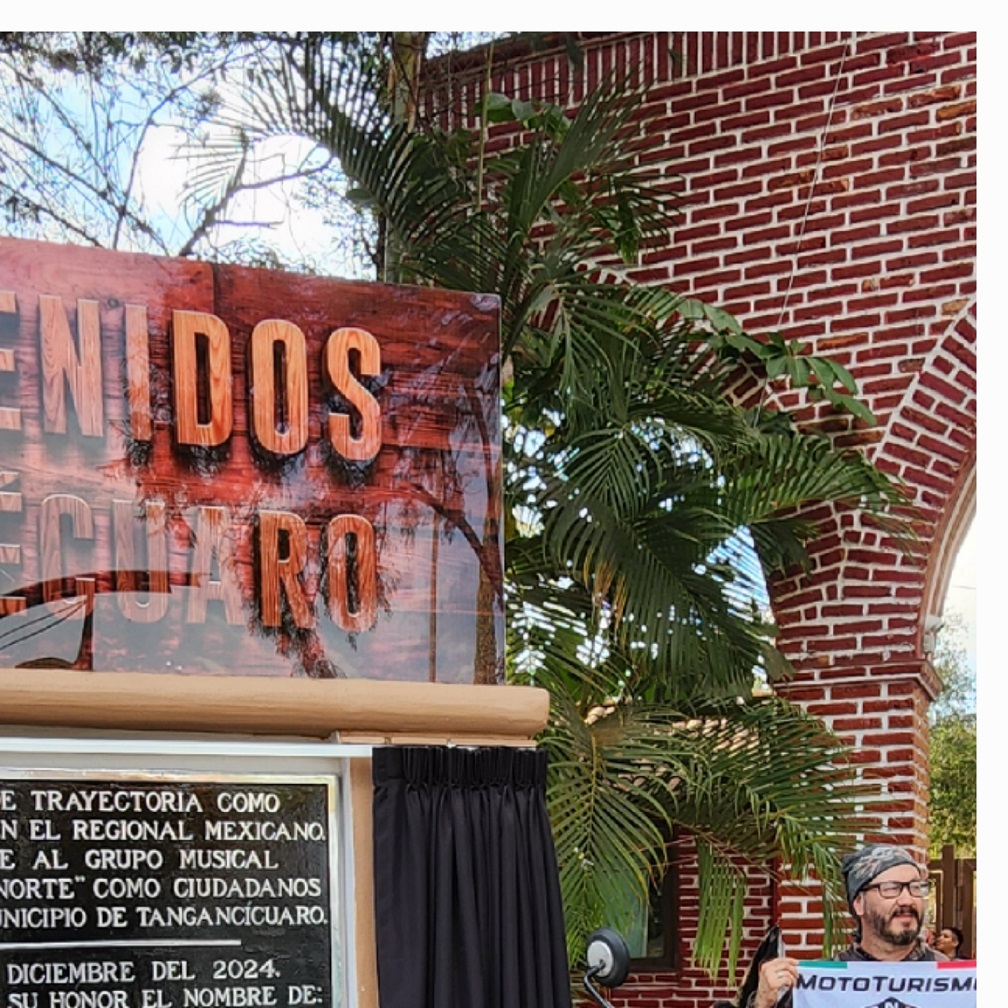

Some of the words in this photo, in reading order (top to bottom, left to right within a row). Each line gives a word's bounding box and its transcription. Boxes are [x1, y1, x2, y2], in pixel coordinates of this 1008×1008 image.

[30, 790, 203, 813] TRAYECTORIA
[217, 792, 281, 813] COMO
[30, 819, 61, 841] EL
[72, 819, 194, 842] REGIONAL
[204, 820, 327, 842] MEXICANO.
[32, 849, 69, 870] AL
[84, 849, 164, 870] GRUPO
[179, 849, 279, 870] MUSICAL
[92, 877, 161, 899] COMO
[173, 877, 322, 898] CIUDADANOS
[96, 906, 128, 928] DE
[135, 901, 329, 928] TANGANCÍCUARO.
[7, 962, 136, 985] DICIEMBRE
[152, 960, 196, 982] DEL
[212, 958, 282, 980] 2024.
[796, 973, 977, 992] MOTOTURISM
[183, 985, 278, 1008] NOMBRE
[288, 984, 324, 1005] DE:
